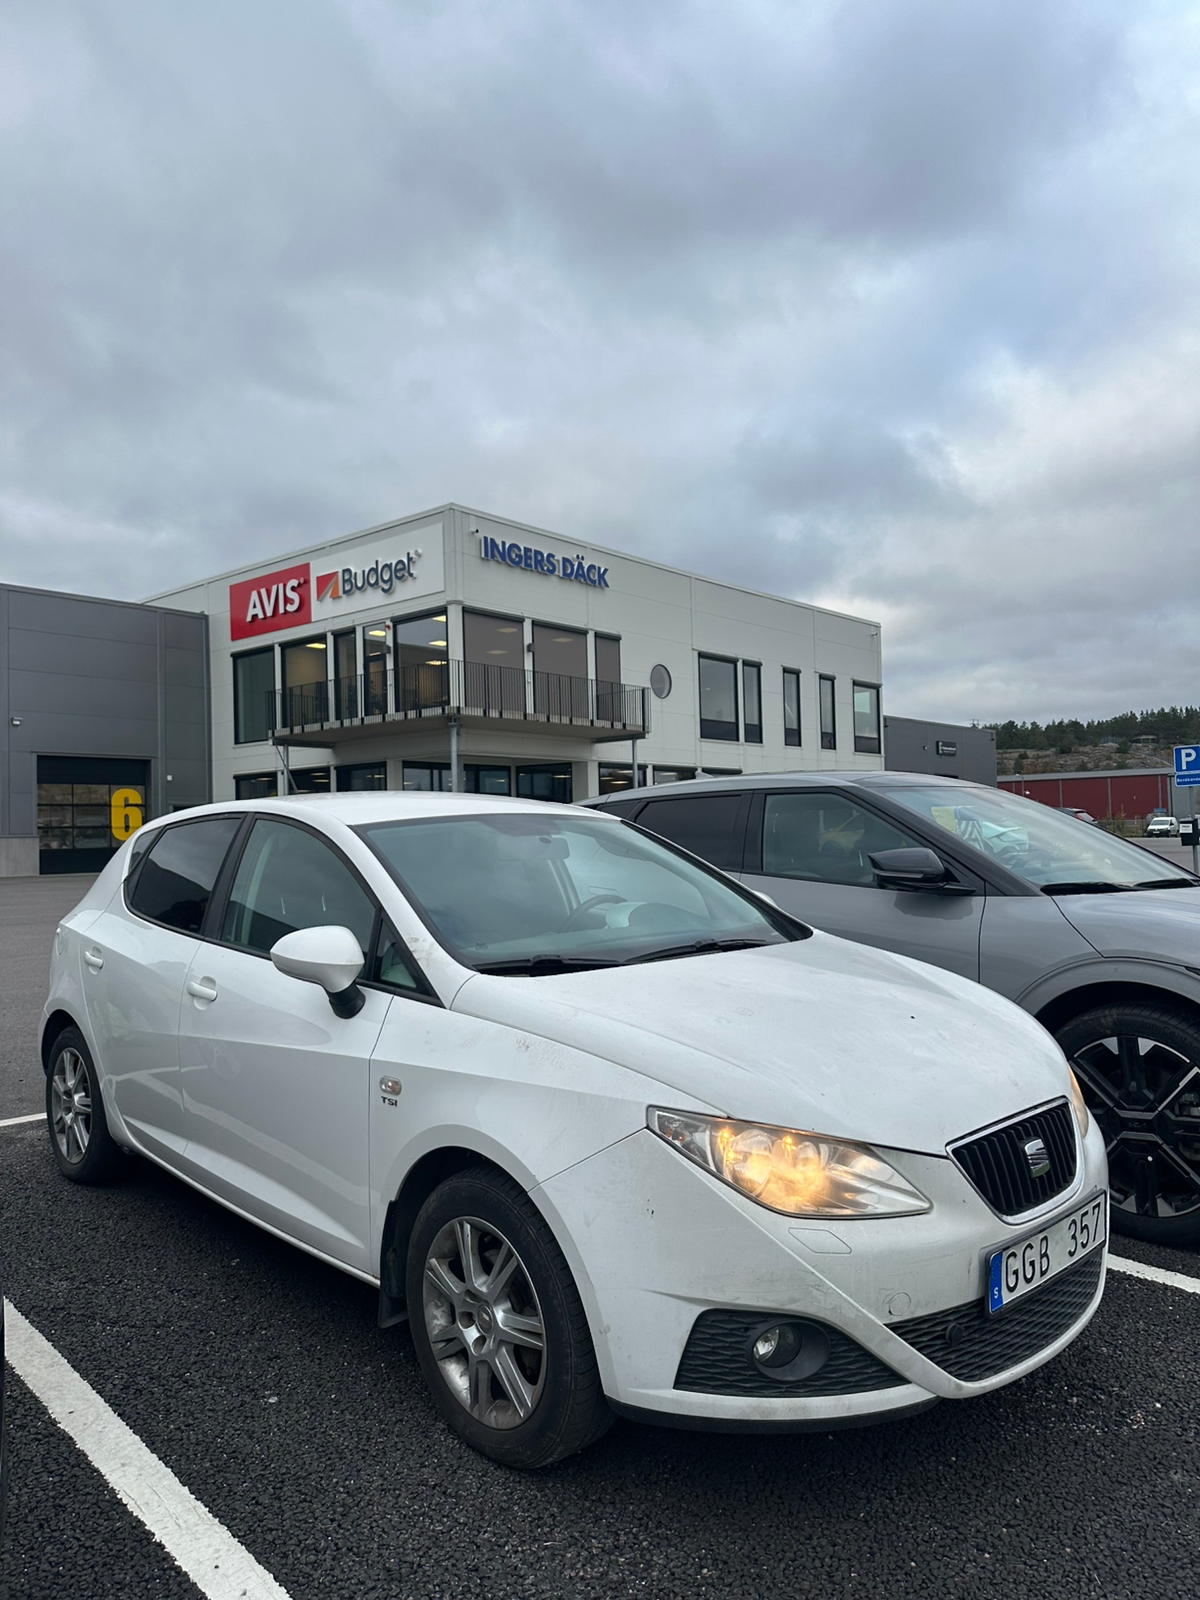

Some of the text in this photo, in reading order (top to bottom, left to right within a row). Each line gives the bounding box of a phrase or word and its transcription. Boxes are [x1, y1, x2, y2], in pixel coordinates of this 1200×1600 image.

[342, 552, 414, 594] Budget
[482, 535, 610, 588] INGERS DÄCK
[246, 578, 301, 622] AVIS
[1181, 748, 1197, 770] P
[111, 788, 143, 841] 6
[381, 1096, 398, 1107] TSI
[1005, 1201, 1101, 1293] GGB 357
[993, 1286, 999, 1299] S
